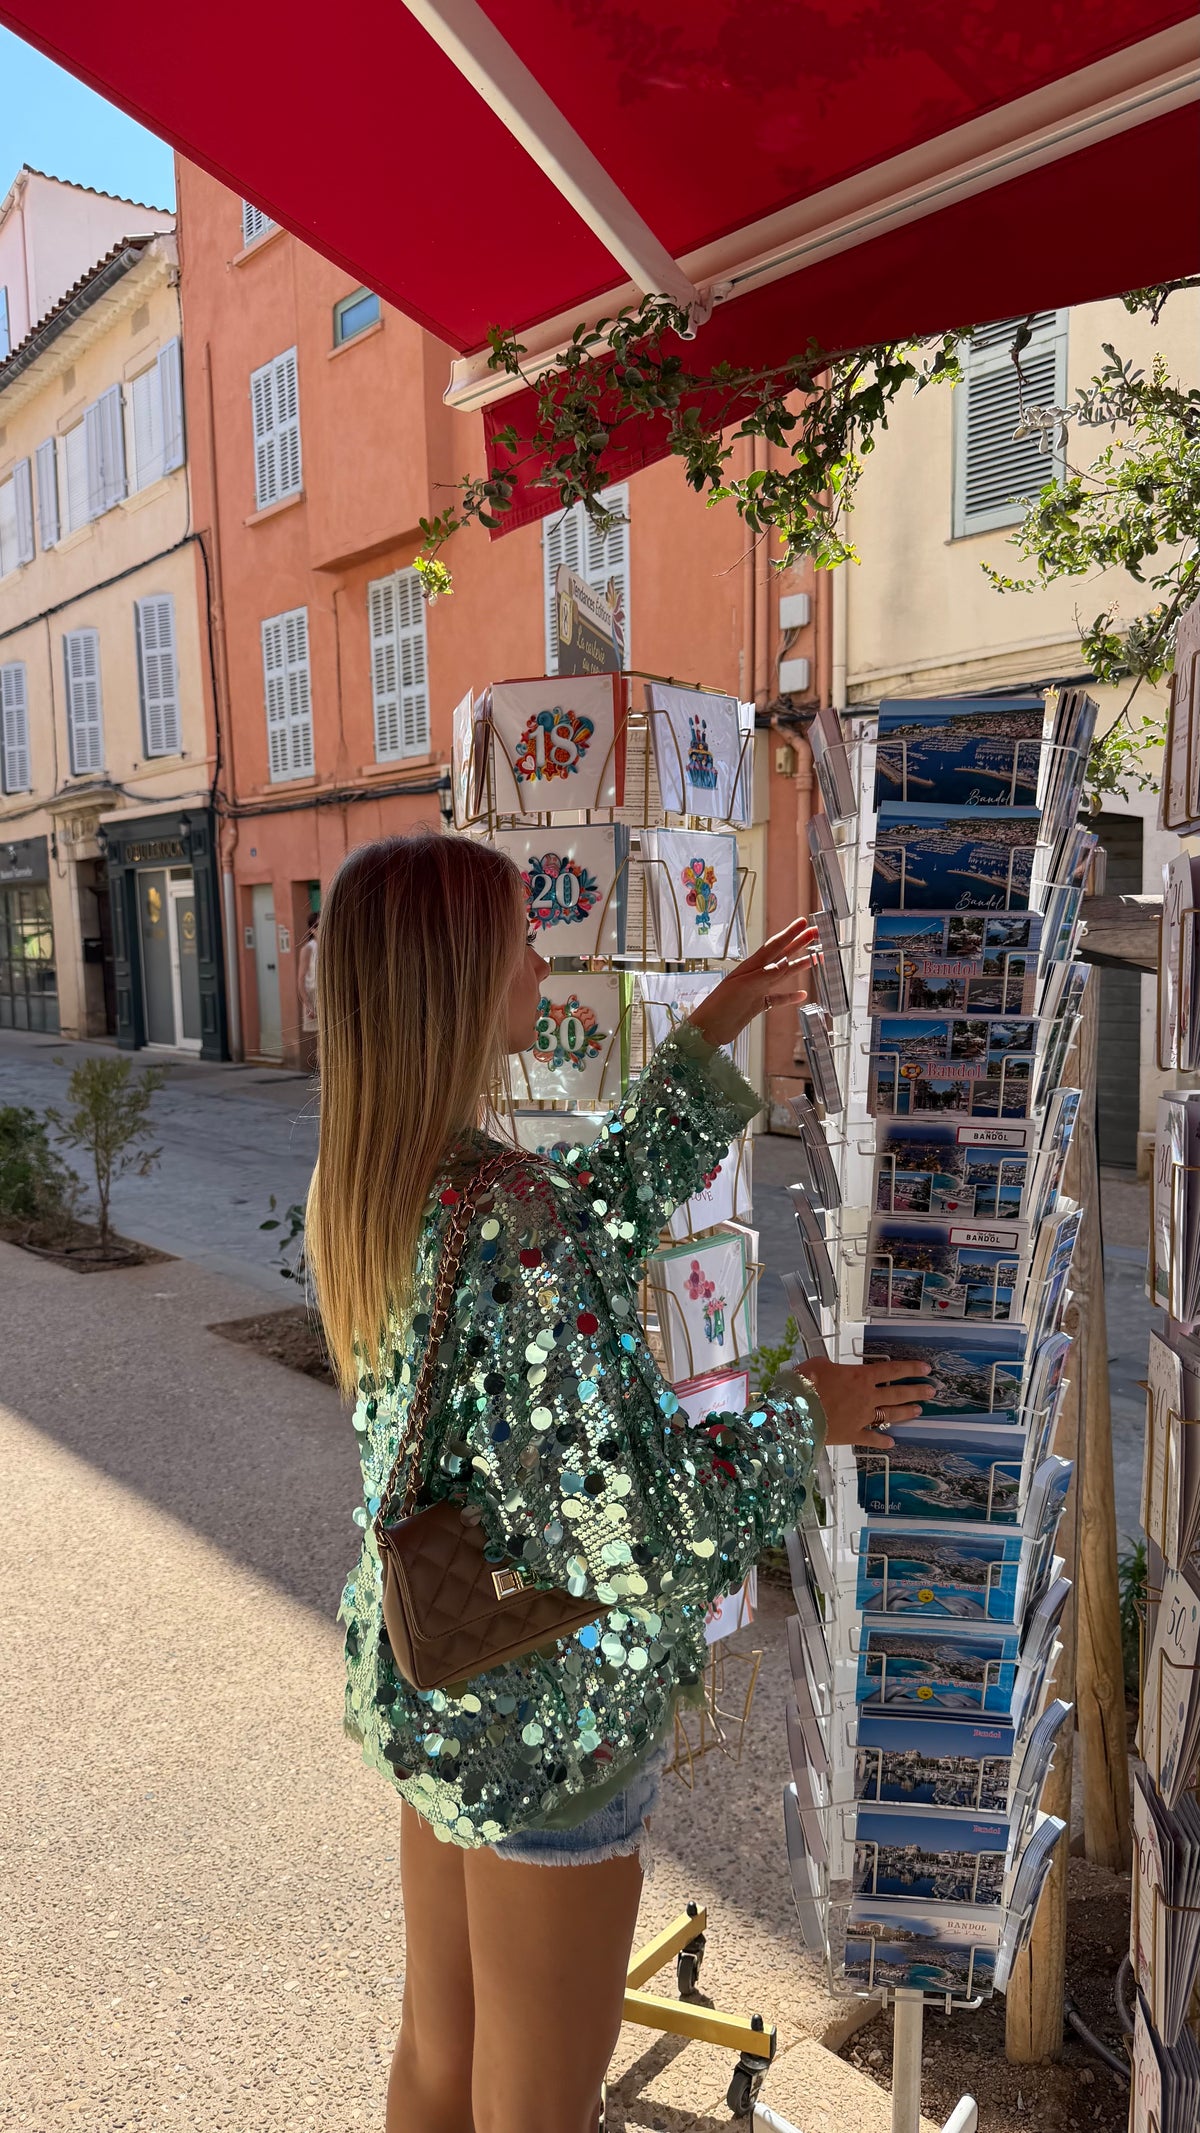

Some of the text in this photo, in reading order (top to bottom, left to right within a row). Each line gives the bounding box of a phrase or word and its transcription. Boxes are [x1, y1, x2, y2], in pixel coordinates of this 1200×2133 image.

[573, 579, 596, 613] Tendances
[528, 723, 578, 768] 18
[965, 788, 1011, 806] Bandol
[531, 873, 581, 909] 20
[955, 891, 1005, 910] Bandol
[923, 960, 977, 976] Bandol
[536, 1016, 585, 1053] 30
[927, 1062, 982, 1078] Bandol
[973, 1133, 1009, 1141] BANDOL
[966, 1233, 1001, 1244] BANDOL
[870, 1500, 902, 1511] Badol
[1166, 1596, 1187, 1646] 50
[948, 1921, 987, 1931] BANDOL
